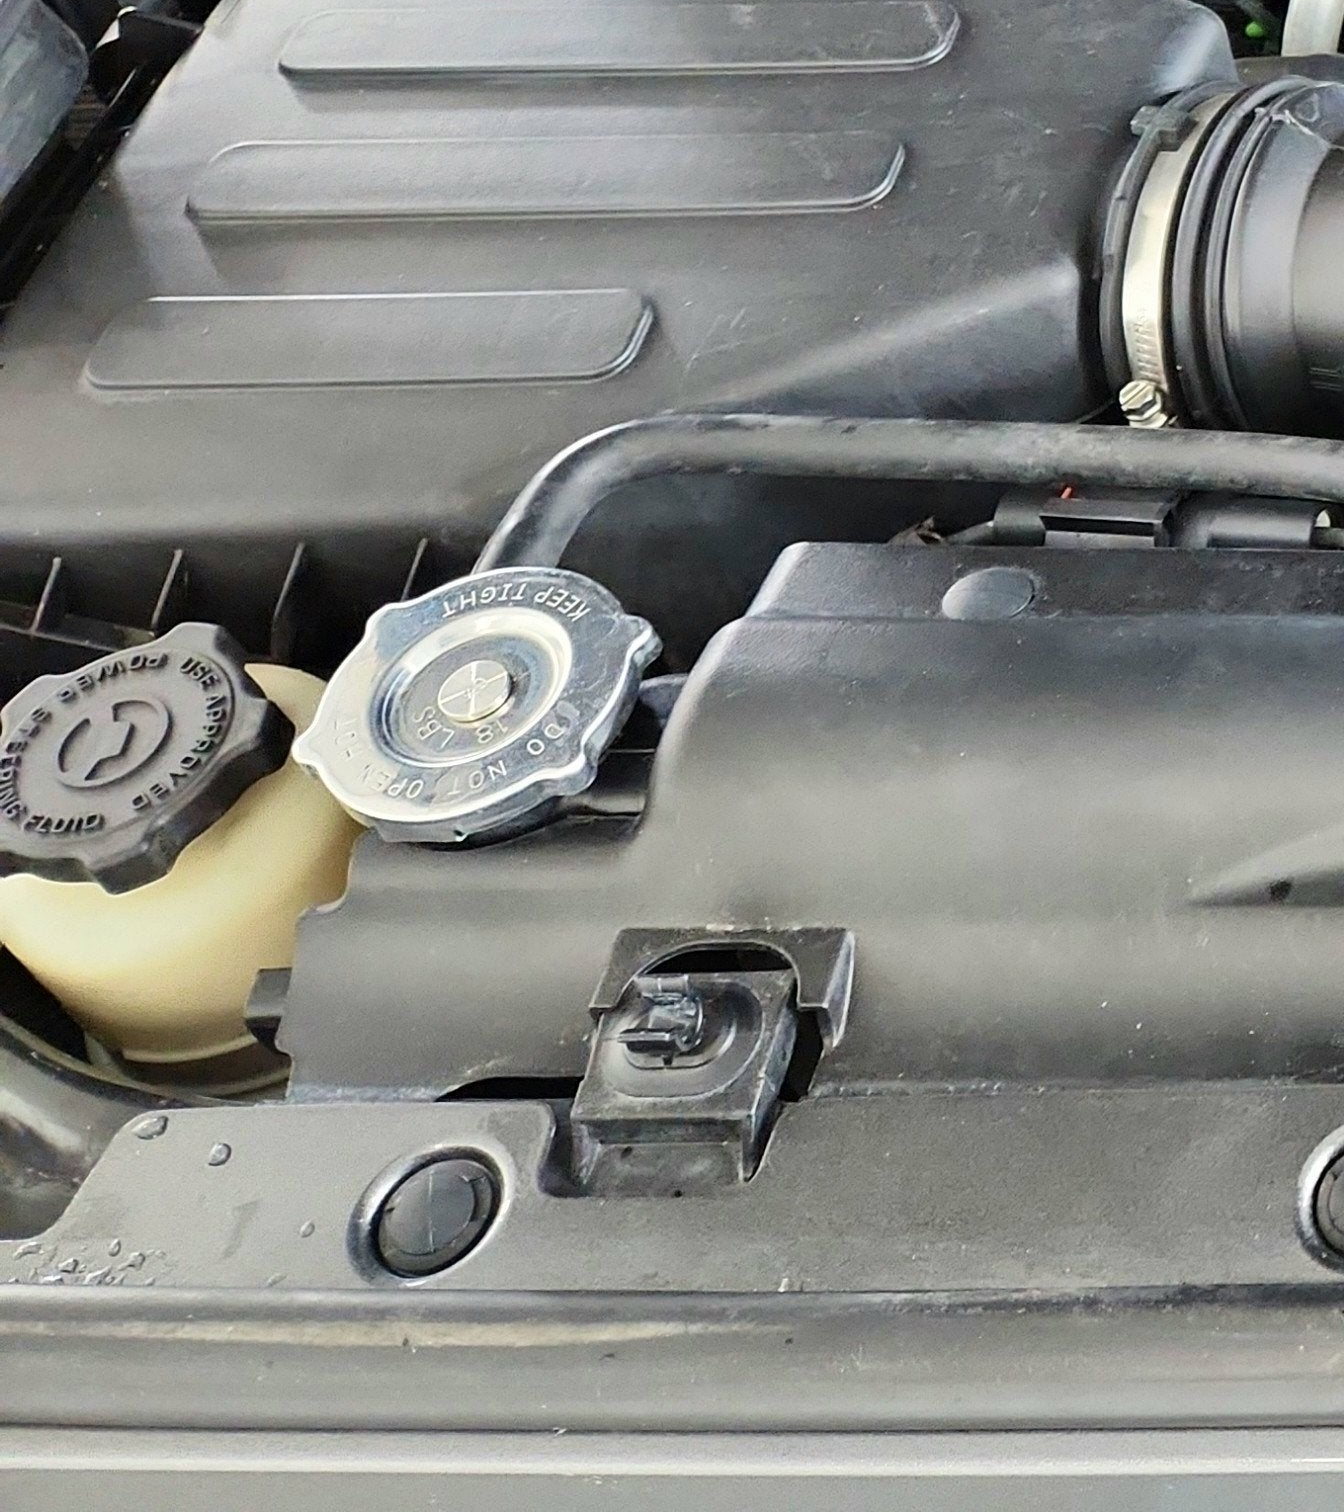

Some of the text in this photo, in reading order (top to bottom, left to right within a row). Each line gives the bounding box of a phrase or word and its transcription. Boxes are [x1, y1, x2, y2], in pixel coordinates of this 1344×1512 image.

[442, 582, 591, 622] KEEP TIGHT
[0, 653, 169, 834] POWER STEERING FLUID
[131, 656, 227, 811] USE APPROVED
[413, 706, 454, 748] LBS
[526, 721, 566, 756] DO
[355, 763, 424, 799] OPEN
[447, 759, 508, 797] NOT
